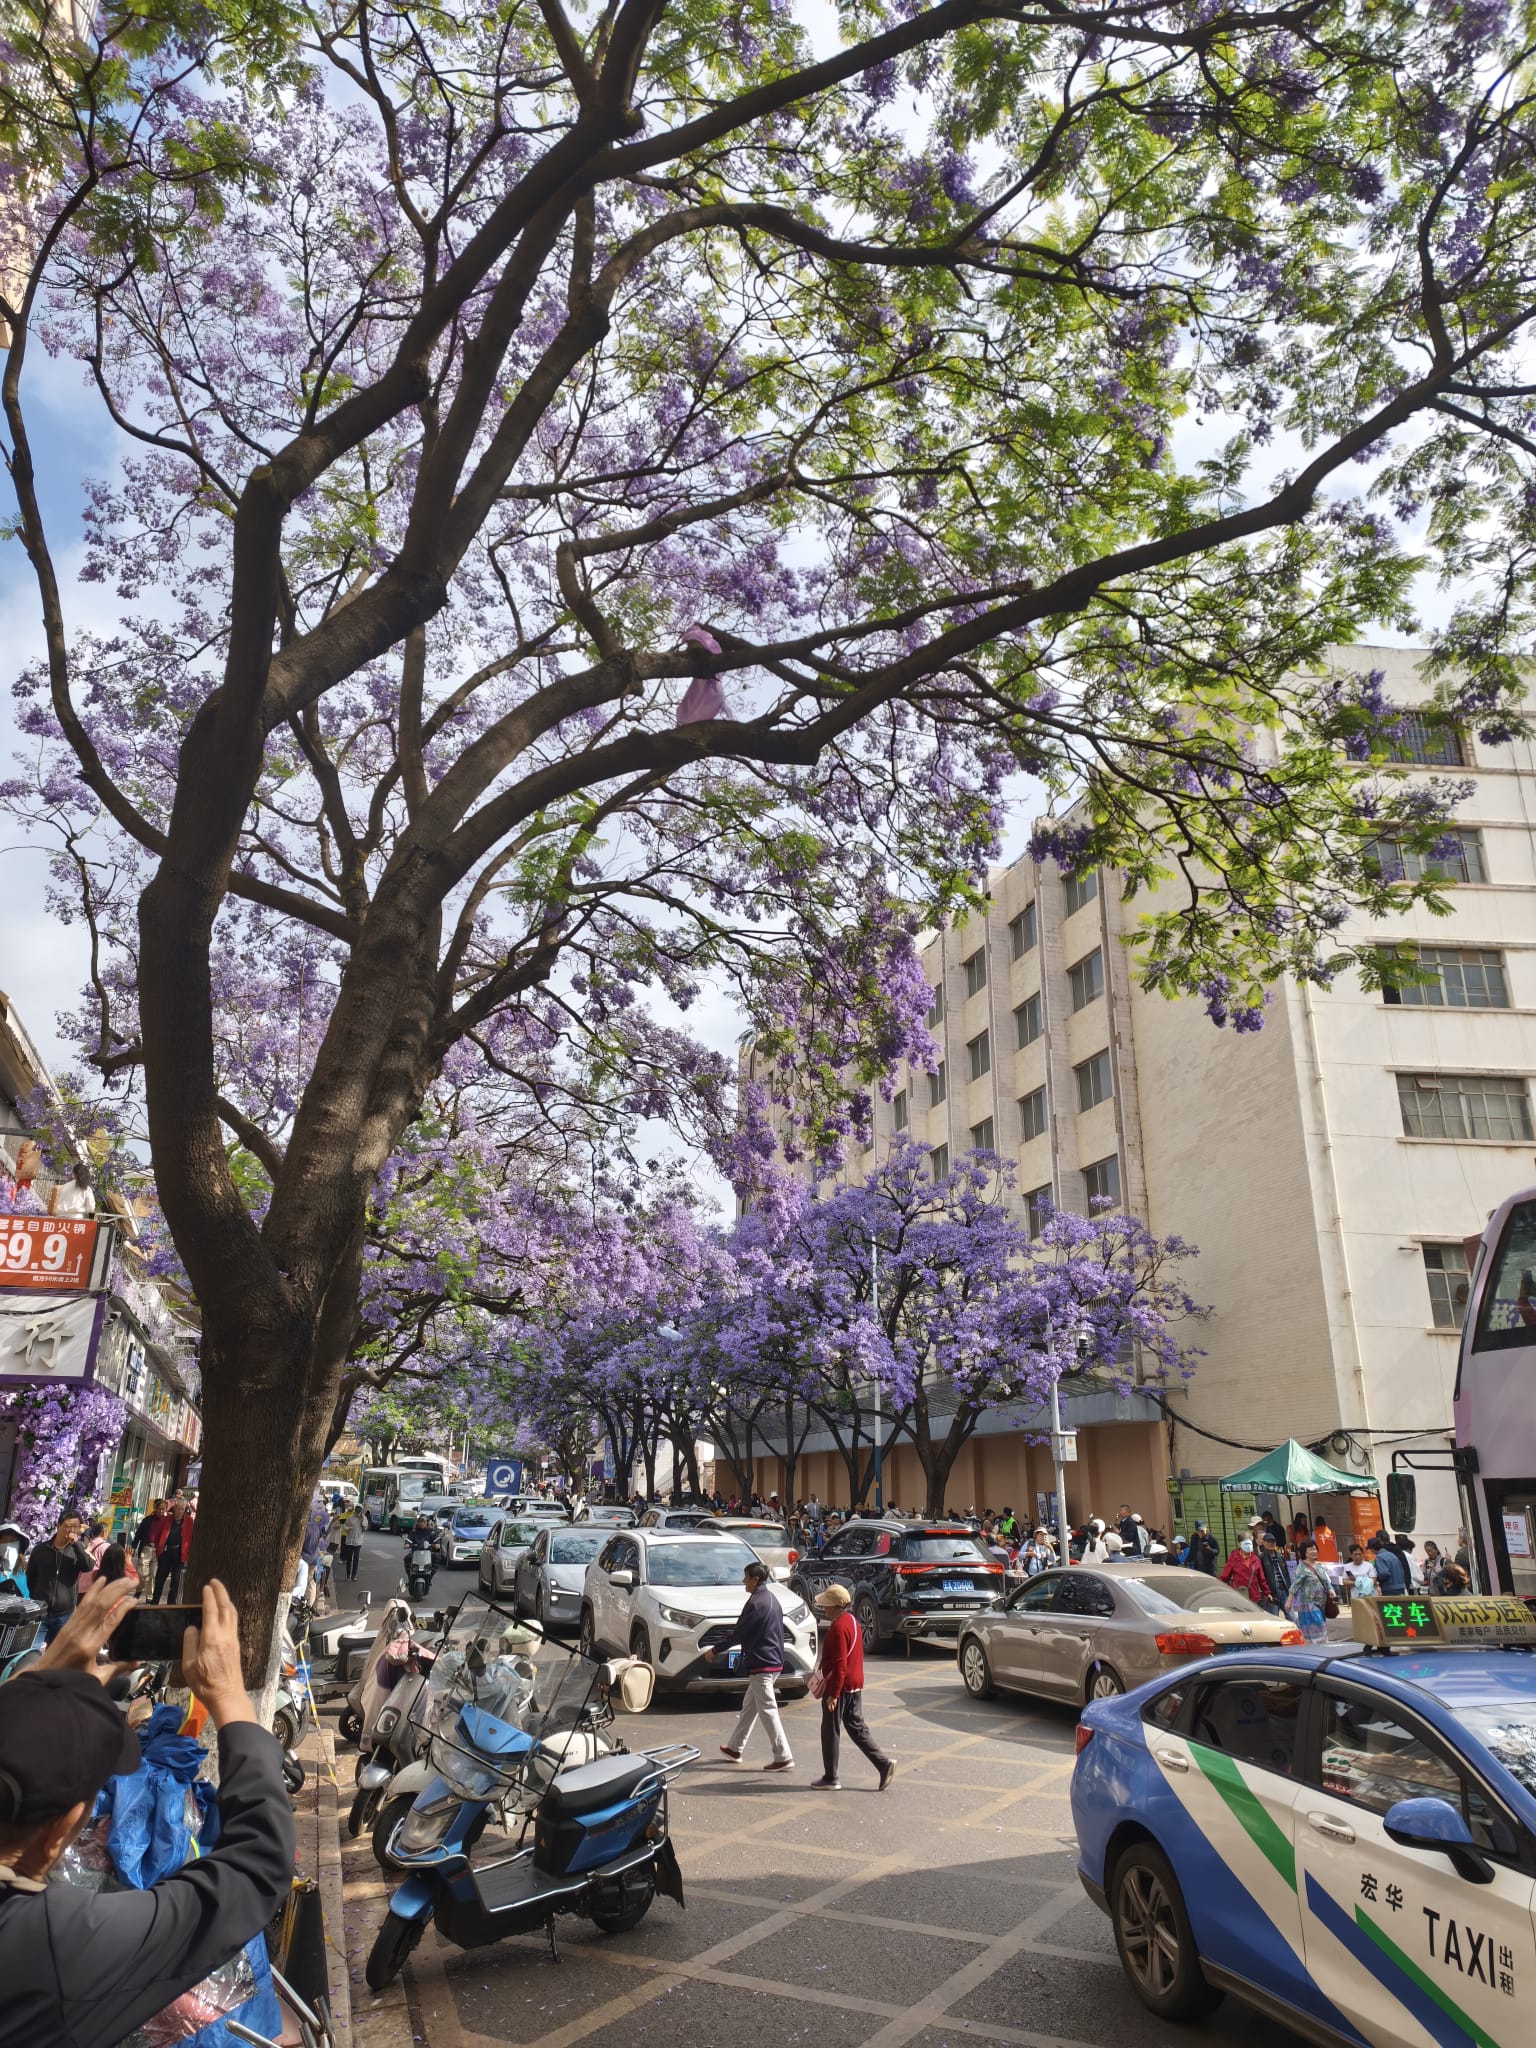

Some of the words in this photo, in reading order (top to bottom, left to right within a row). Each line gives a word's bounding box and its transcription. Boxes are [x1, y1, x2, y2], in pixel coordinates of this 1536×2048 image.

[14, 1316, 75, 1369] 行
[1383, 1602, 1430, 1627] 空车
[1360, 1873, 1403, 1912] 宏华
[1423, 1906, 1496, 1989] TAXI
[1499, 1945, 1515, 1998] 出租
